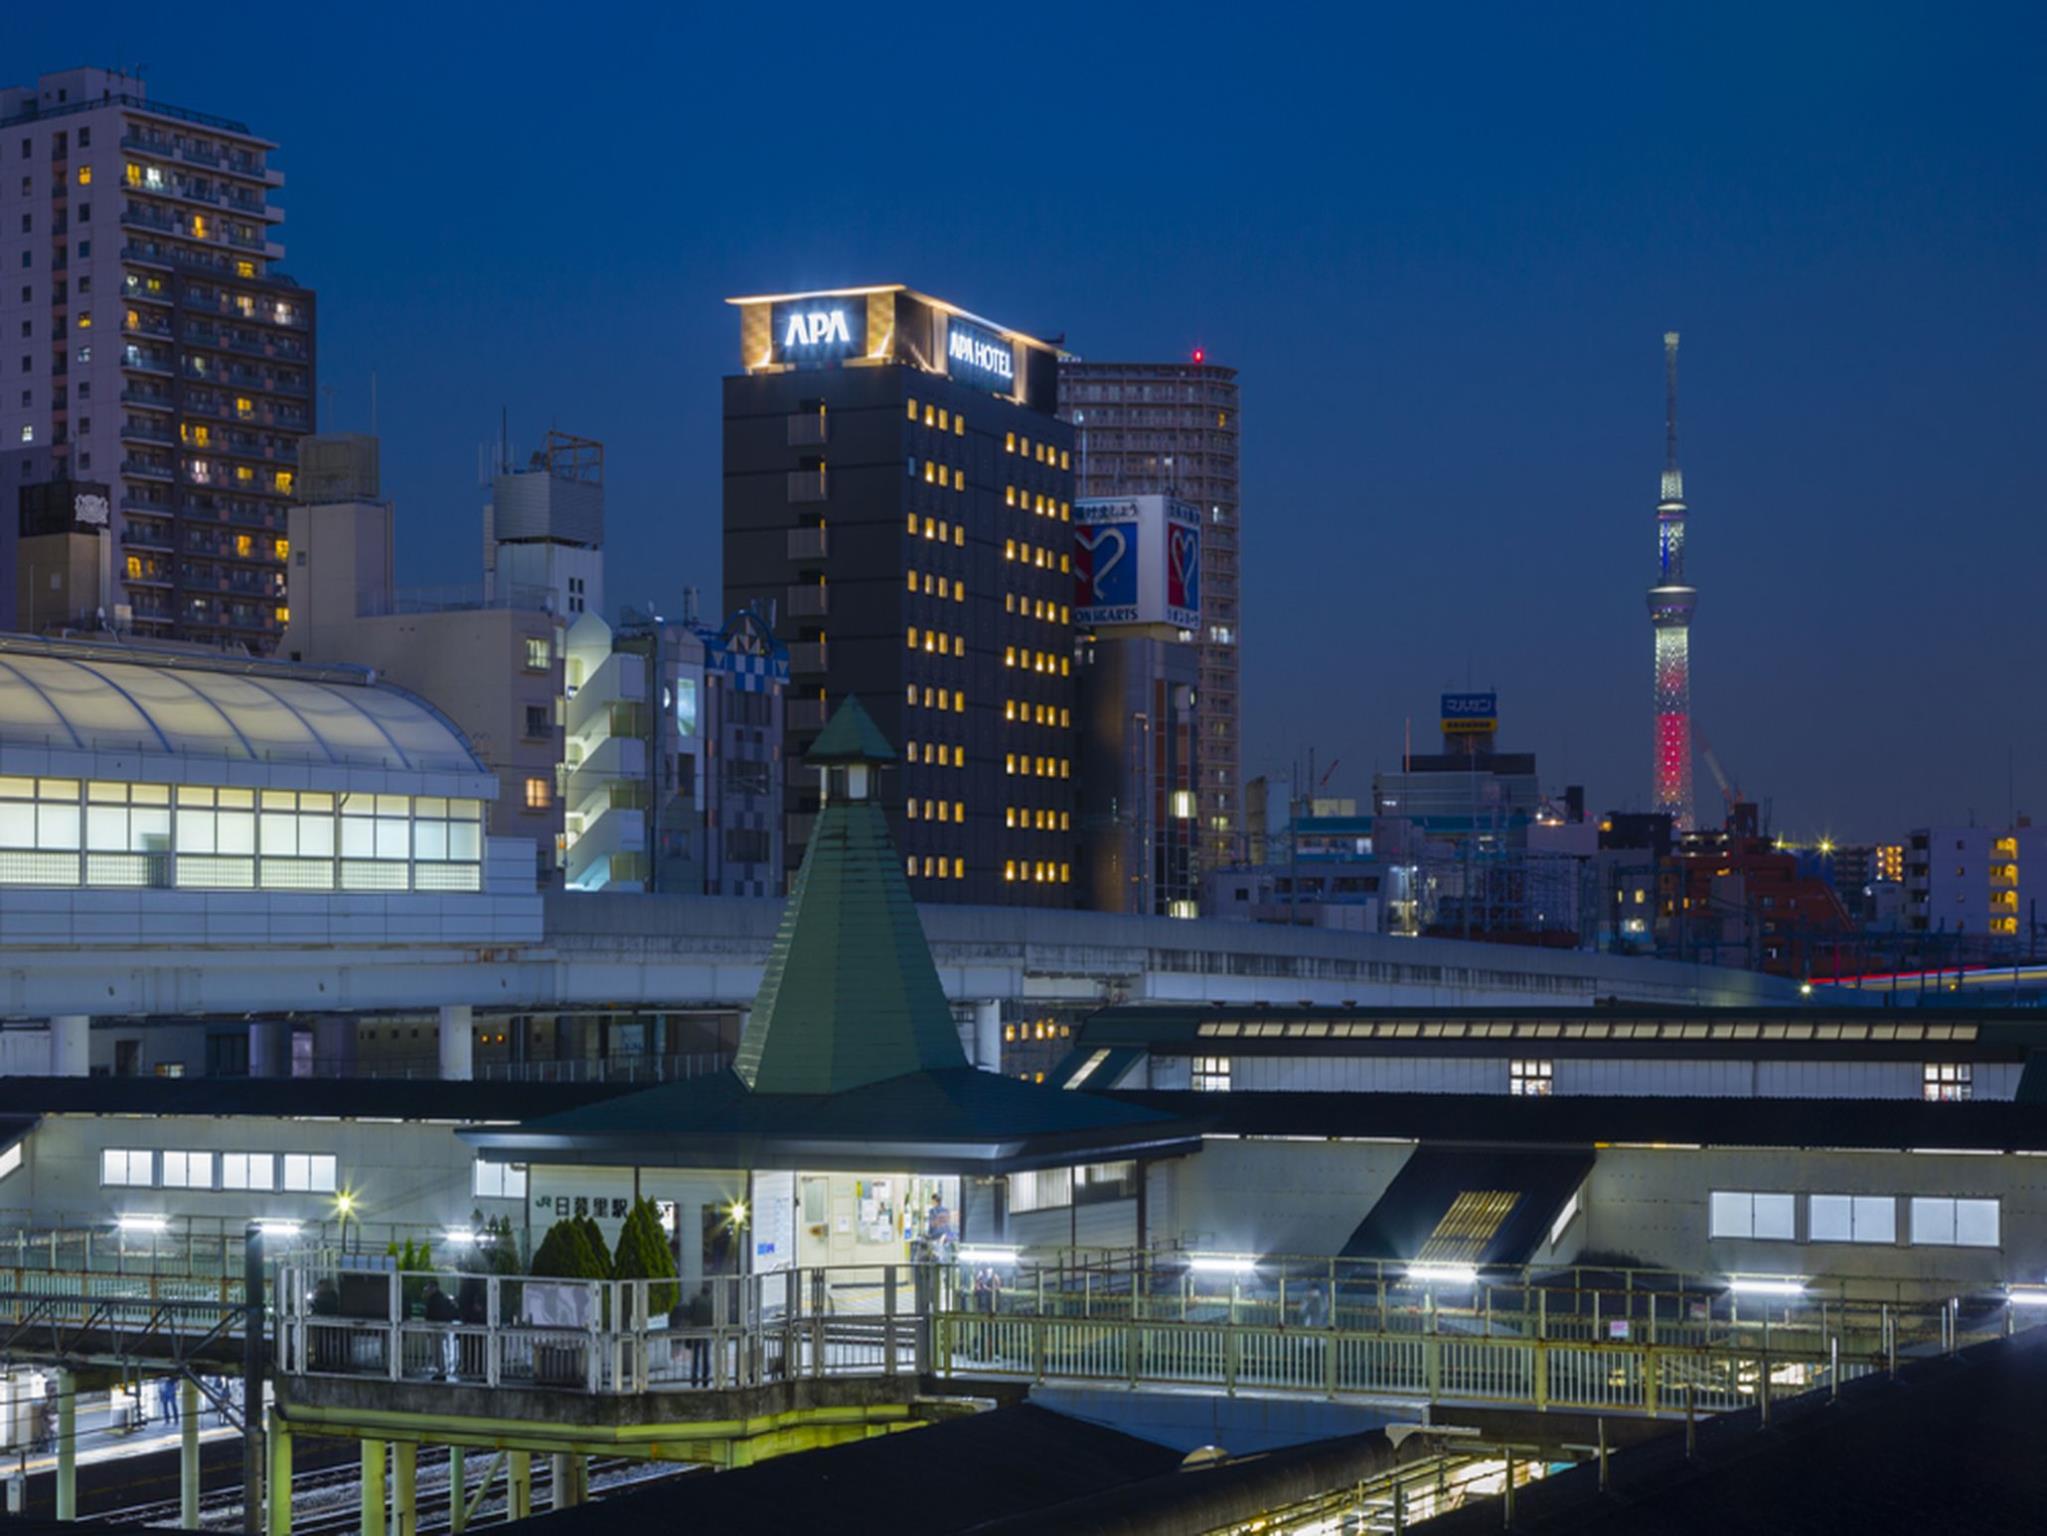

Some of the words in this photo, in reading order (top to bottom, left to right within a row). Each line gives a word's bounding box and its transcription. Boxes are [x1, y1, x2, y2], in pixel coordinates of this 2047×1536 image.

[784, 310, 851, 347] APA
[949, 331, 974, 364] APA
[975, 340, 1014, 379] HOTEL
